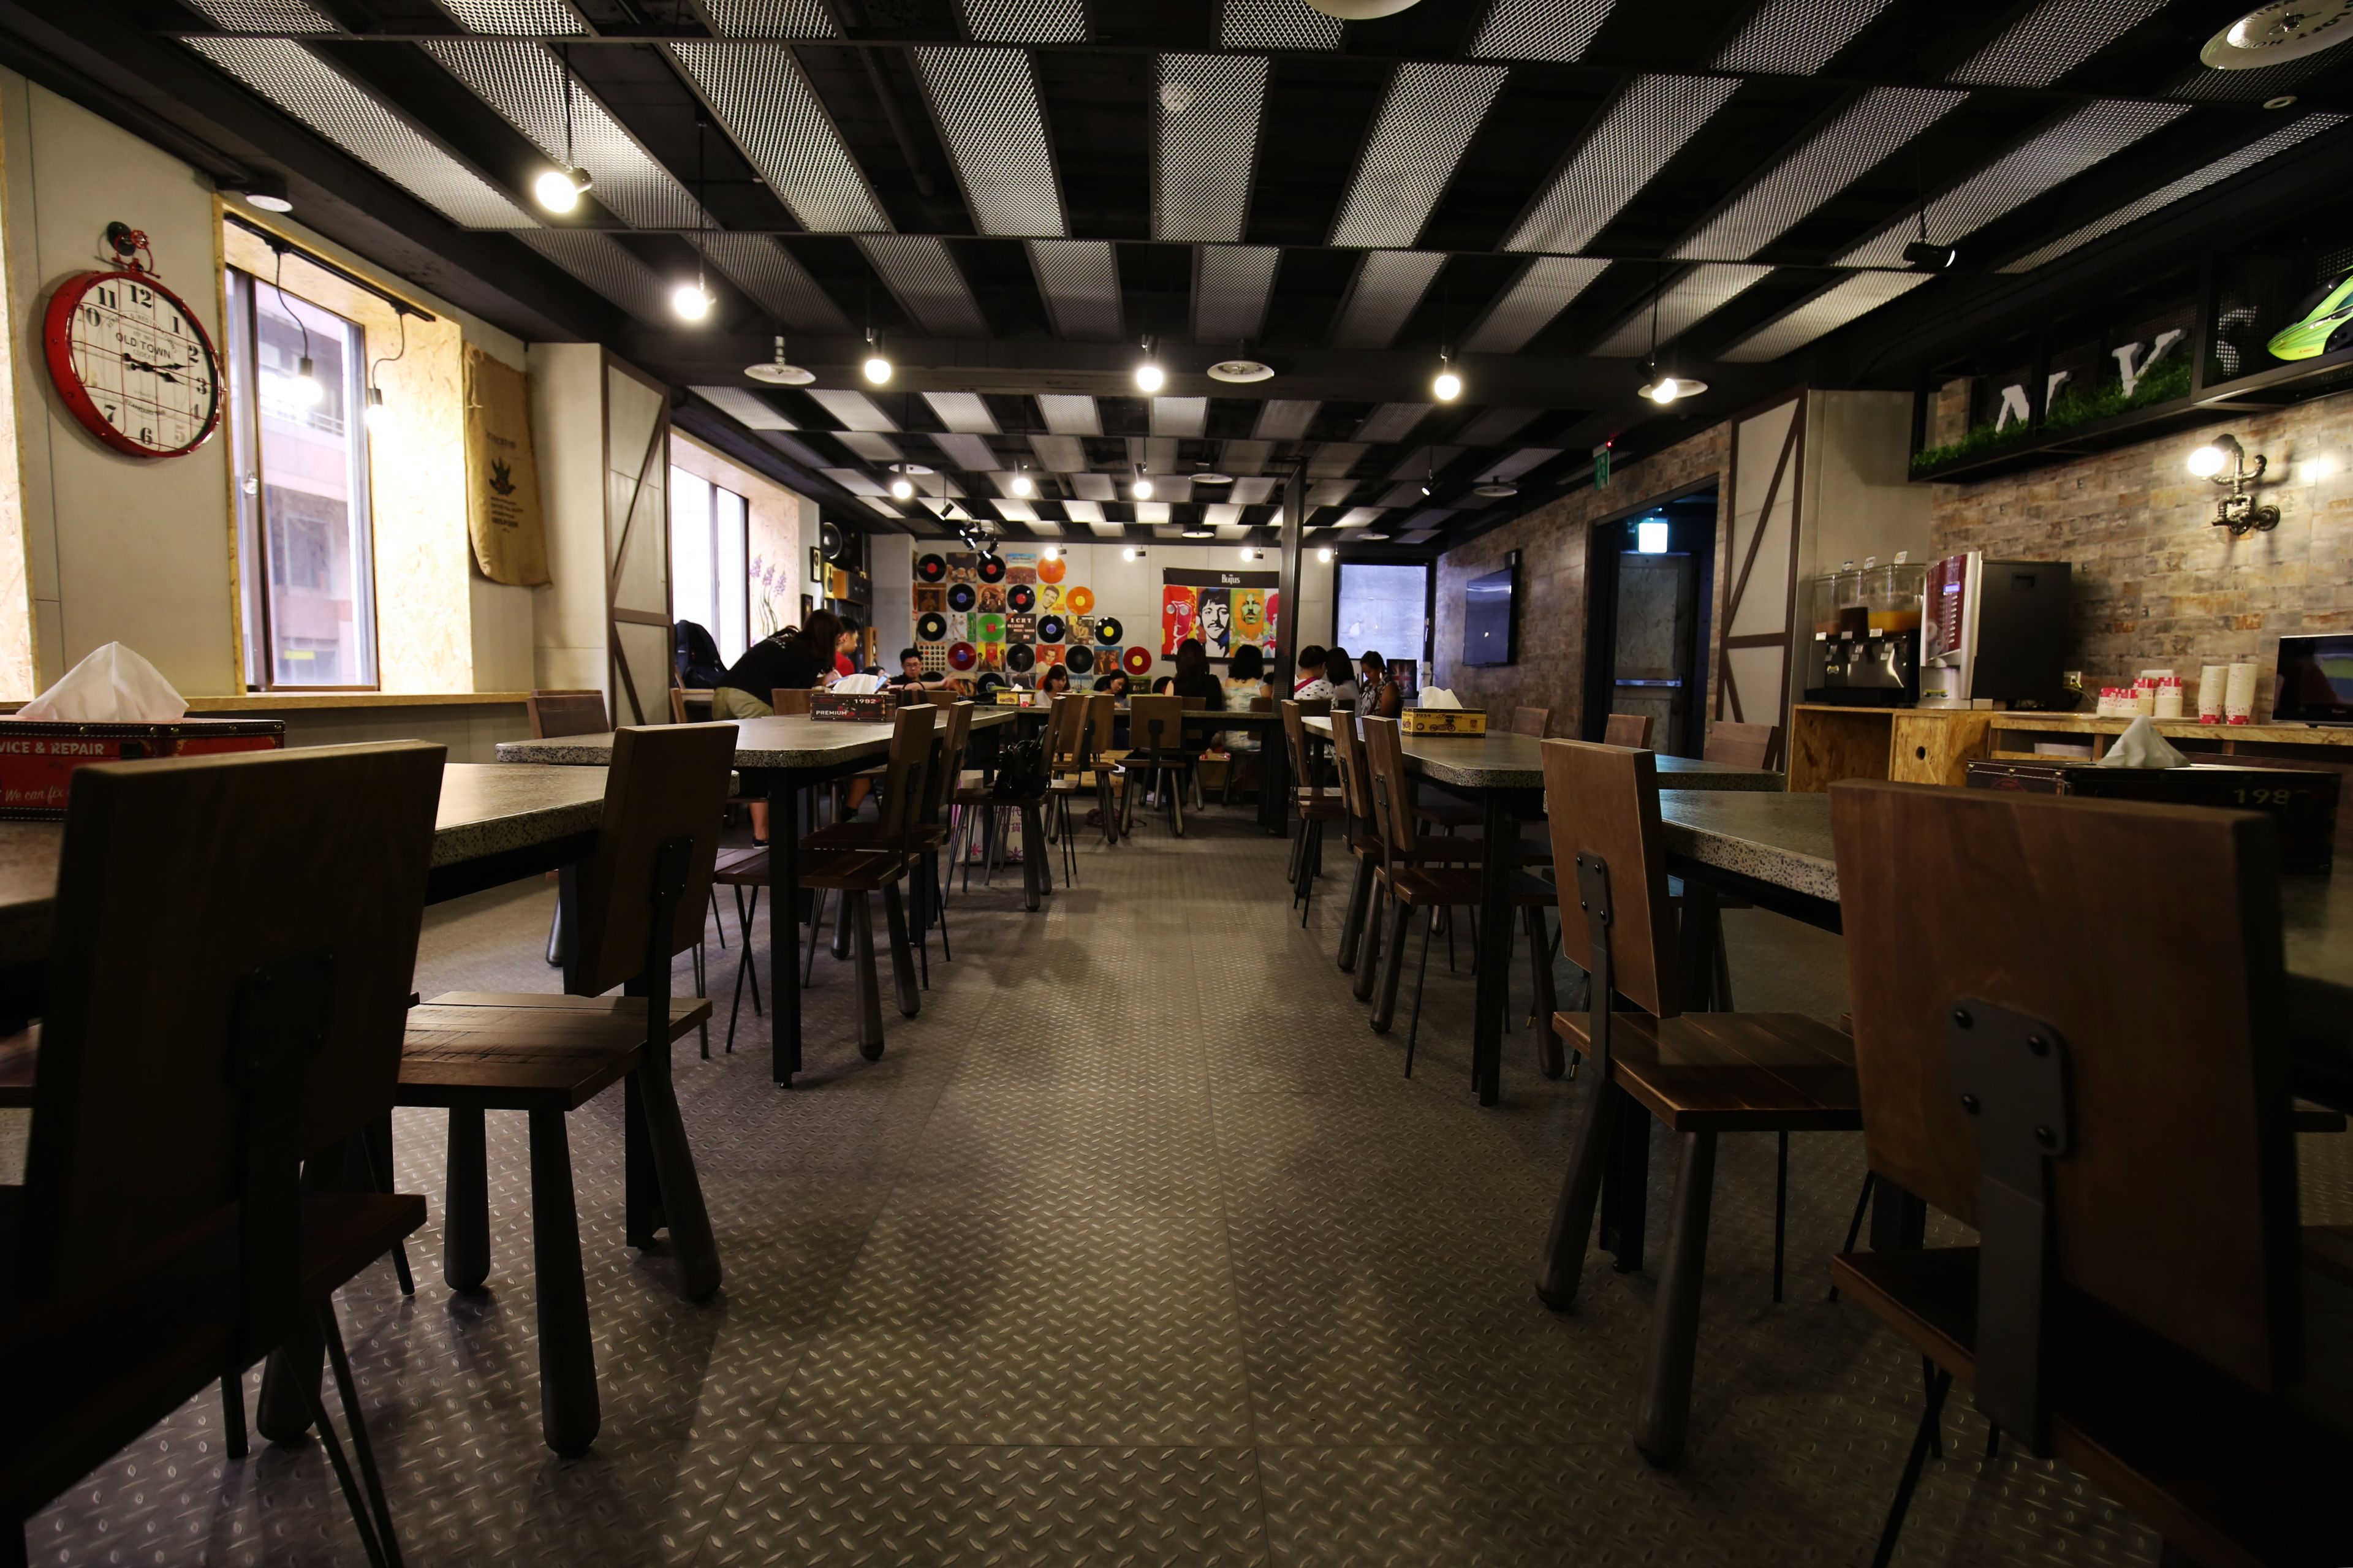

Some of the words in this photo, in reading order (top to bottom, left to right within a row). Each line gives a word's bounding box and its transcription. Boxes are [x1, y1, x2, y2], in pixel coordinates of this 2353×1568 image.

[97, 286, 117, 309] 11
[130, 284, 152, 308] 12
[172, 316, 180, 335] 1
[116, 333, 137, 347] OLD
[140, 341, 171, 360] TOWN
[188, 345, 199, 363] 2
[197, 377, 207, 395] 3
[104, 403, 116, 423] 7
[140, 427, 153, 445] 6
[174, 425, 186, 443] 5
[35, 742, 45, 754] &
[51, 743, 104, 756] REPAIR
[5, 789, 21, 802] We
[2234, 788, 2310, 805] 198
